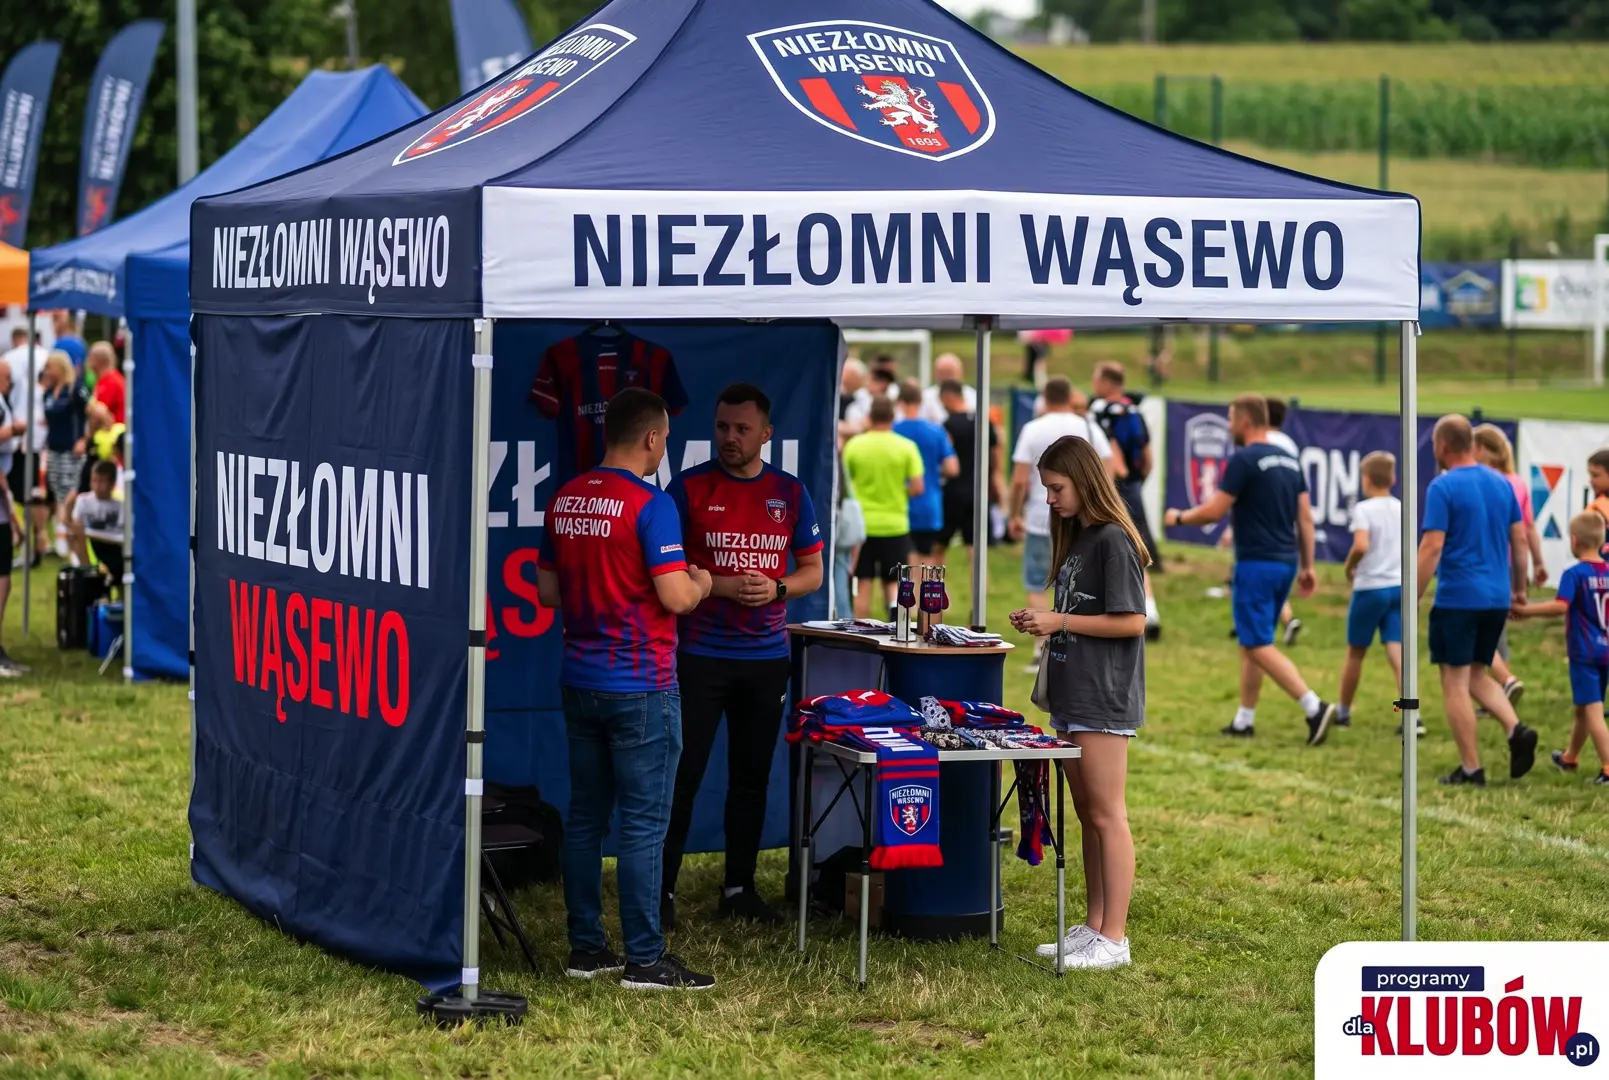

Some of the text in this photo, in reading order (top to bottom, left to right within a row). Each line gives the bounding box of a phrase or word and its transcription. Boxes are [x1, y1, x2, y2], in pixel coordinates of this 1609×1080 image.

[773, 31, 946, 63] NIEZŁOMNI
[808, 53, 936, 78] WĄSEWO
[212, 215, 449, 304] NIEZŁOMNI WĄSEWO
[573, 212, 1344, 306] NIEZŁOMNI WĄSEWO
[553, 496, 624, 518] NIEZŁOMNI
[217, 451, 430, 589] NIEZŁOMNI
[554, 517, 611, 539] WĄSEWO
[706, 532, 787, 551] NIEZŁOMNI
[713, 551, 779, 571] WĄSEWO
[229, 578, 410, 727] WĄSEWO
[892, 788, 930, 799] NIEZŁOMNI
